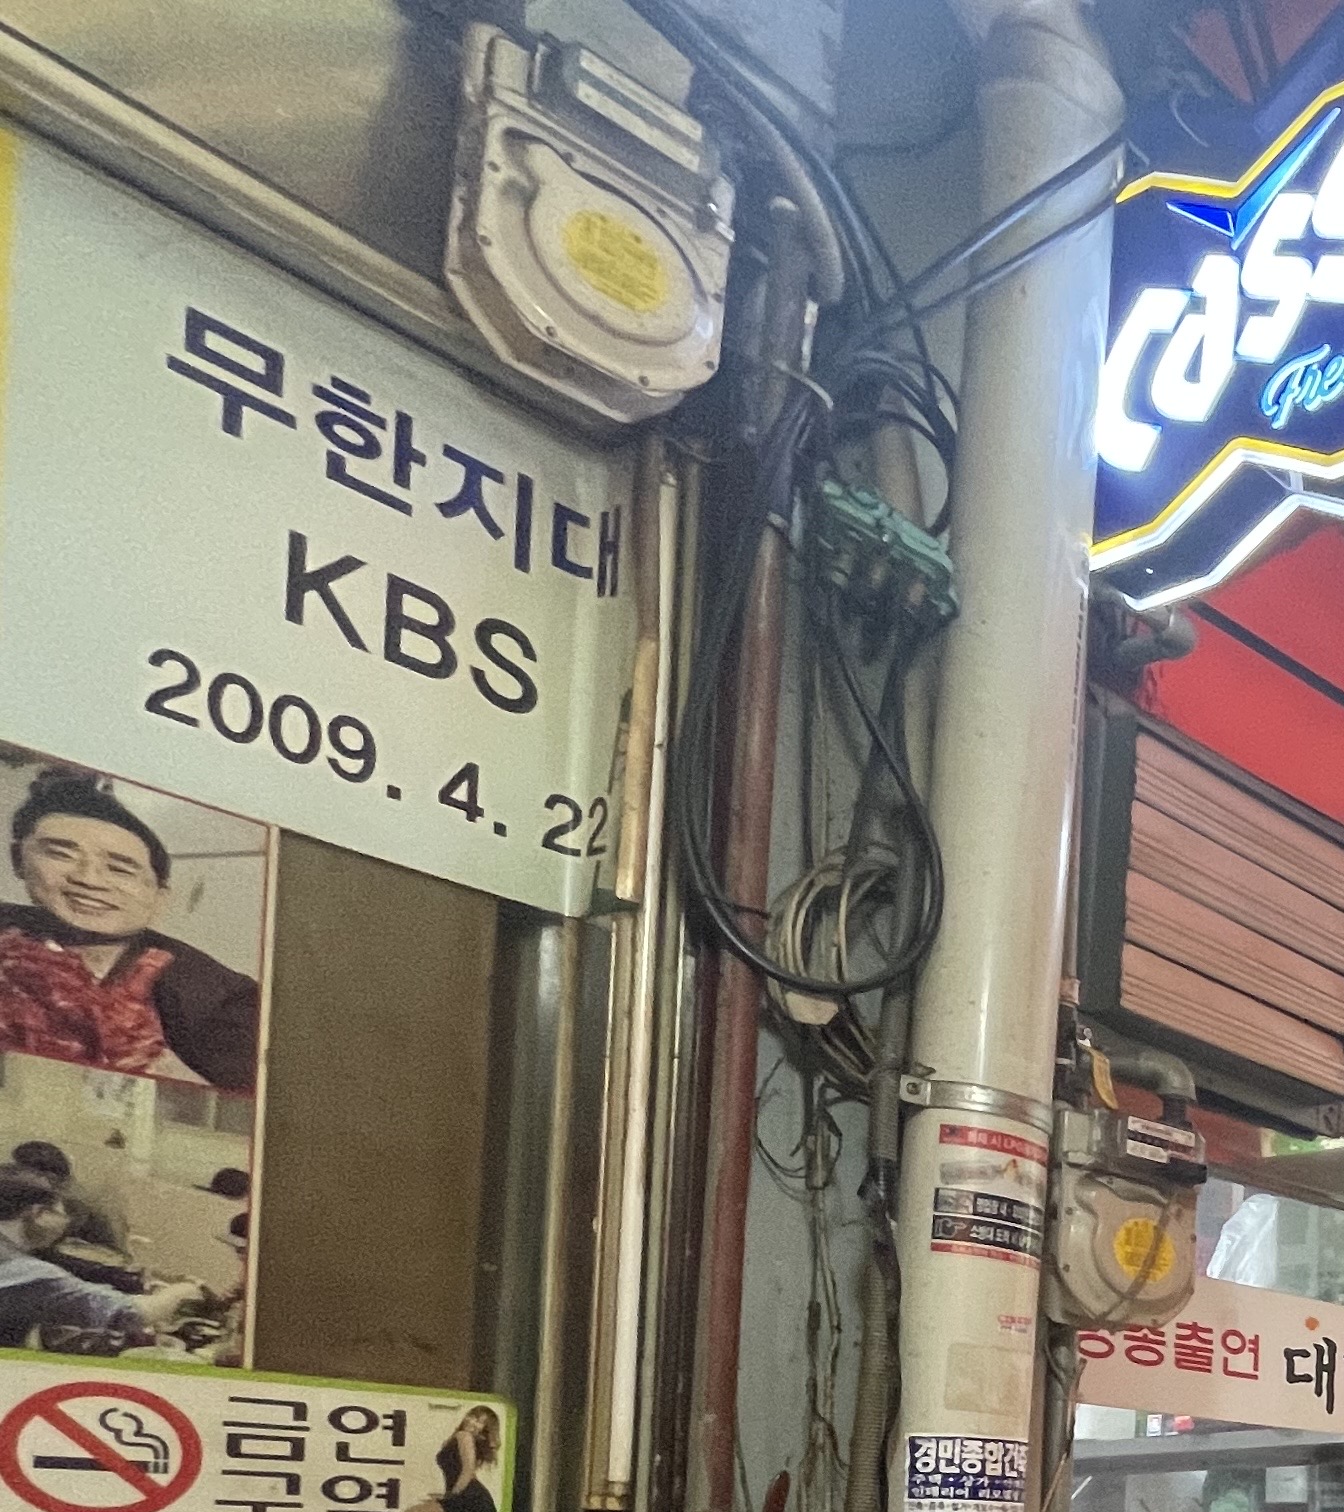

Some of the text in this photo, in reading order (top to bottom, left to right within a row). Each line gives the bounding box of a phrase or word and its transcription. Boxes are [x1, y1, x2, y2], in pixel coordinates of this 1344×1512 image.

[166, 306, 621, 600] 무한지대
[285, 529, 539, 715] KBS
[222, 1395, 408, 1467] 금연
